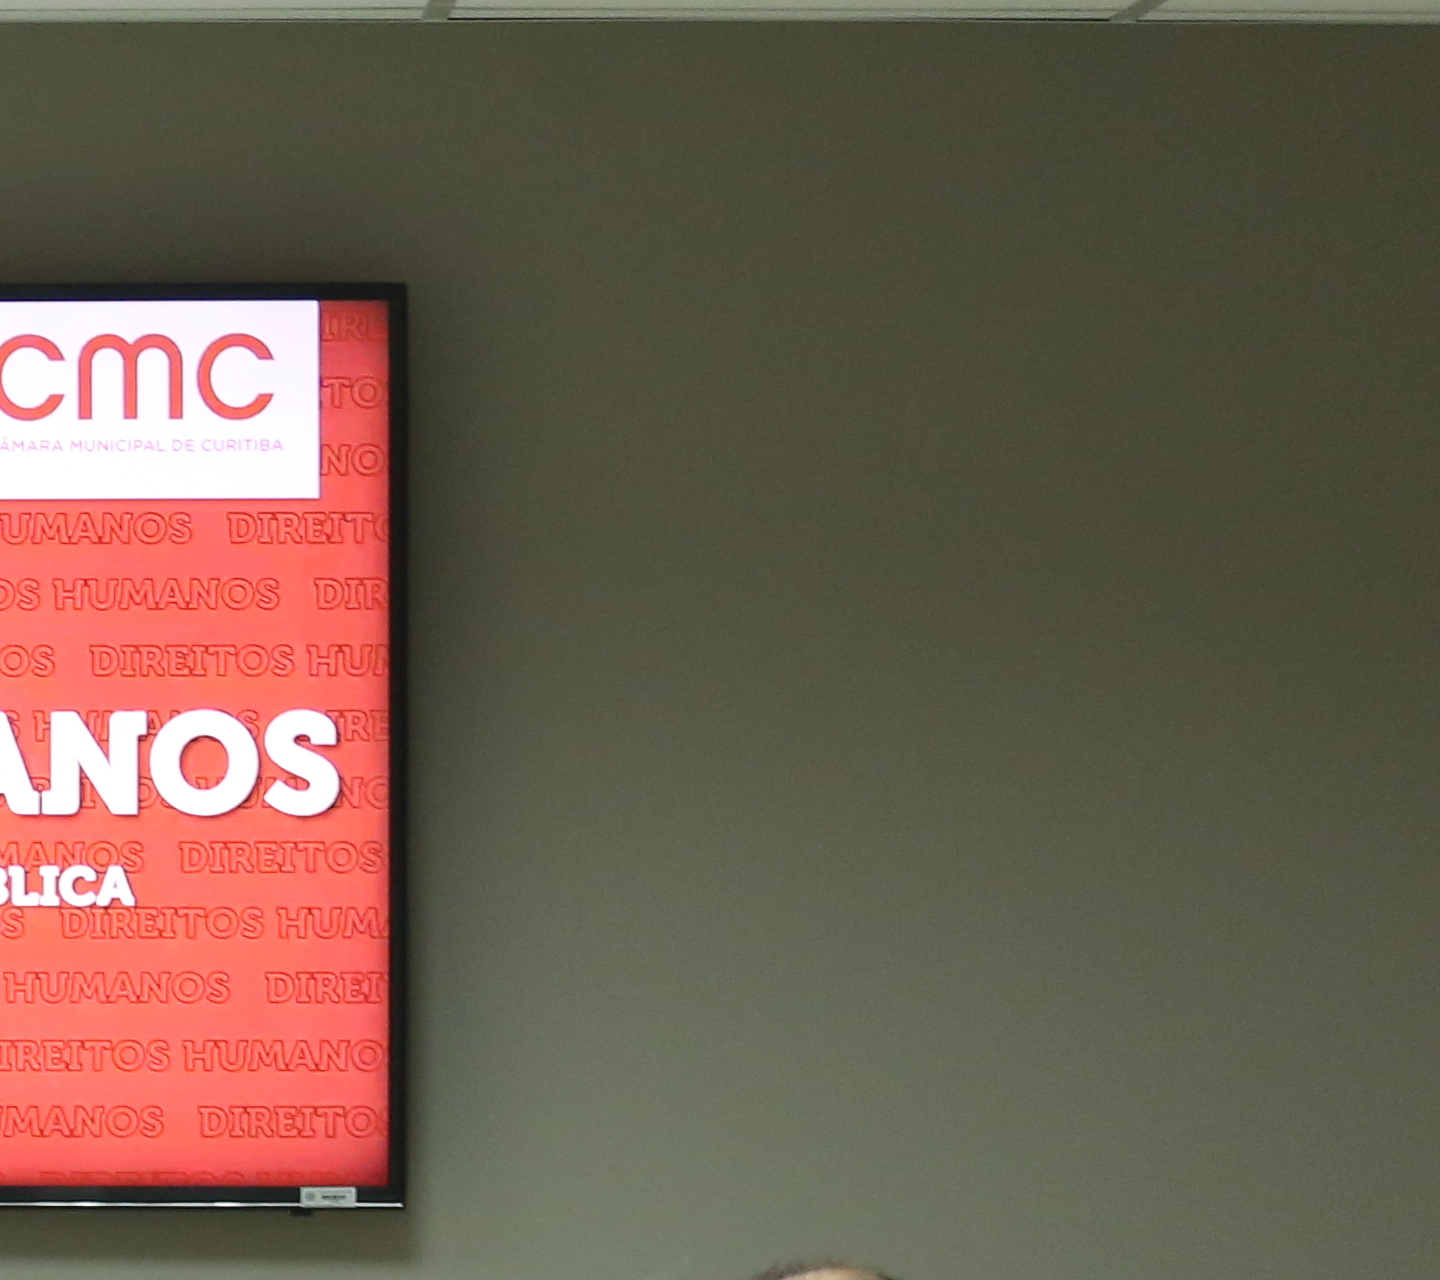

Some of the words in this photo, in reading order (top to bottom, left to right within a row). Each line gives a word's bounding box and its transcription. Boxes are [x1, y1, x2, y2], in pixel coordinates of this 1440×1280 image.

[70, 439, 166, 453] MUNICIPAL
[172, 439, 195, 453] DE
[201, 439, 284, 453] CURITIBA
[52, 576, 281, 611] HUMANOS
[89, 643, 295, 677] DIREITOS
[179, 839, 384, 874] DIREITOS
[60, 906, 265, 941] DIREITOS
[2, 970, 231, 1004] HUMANOS
